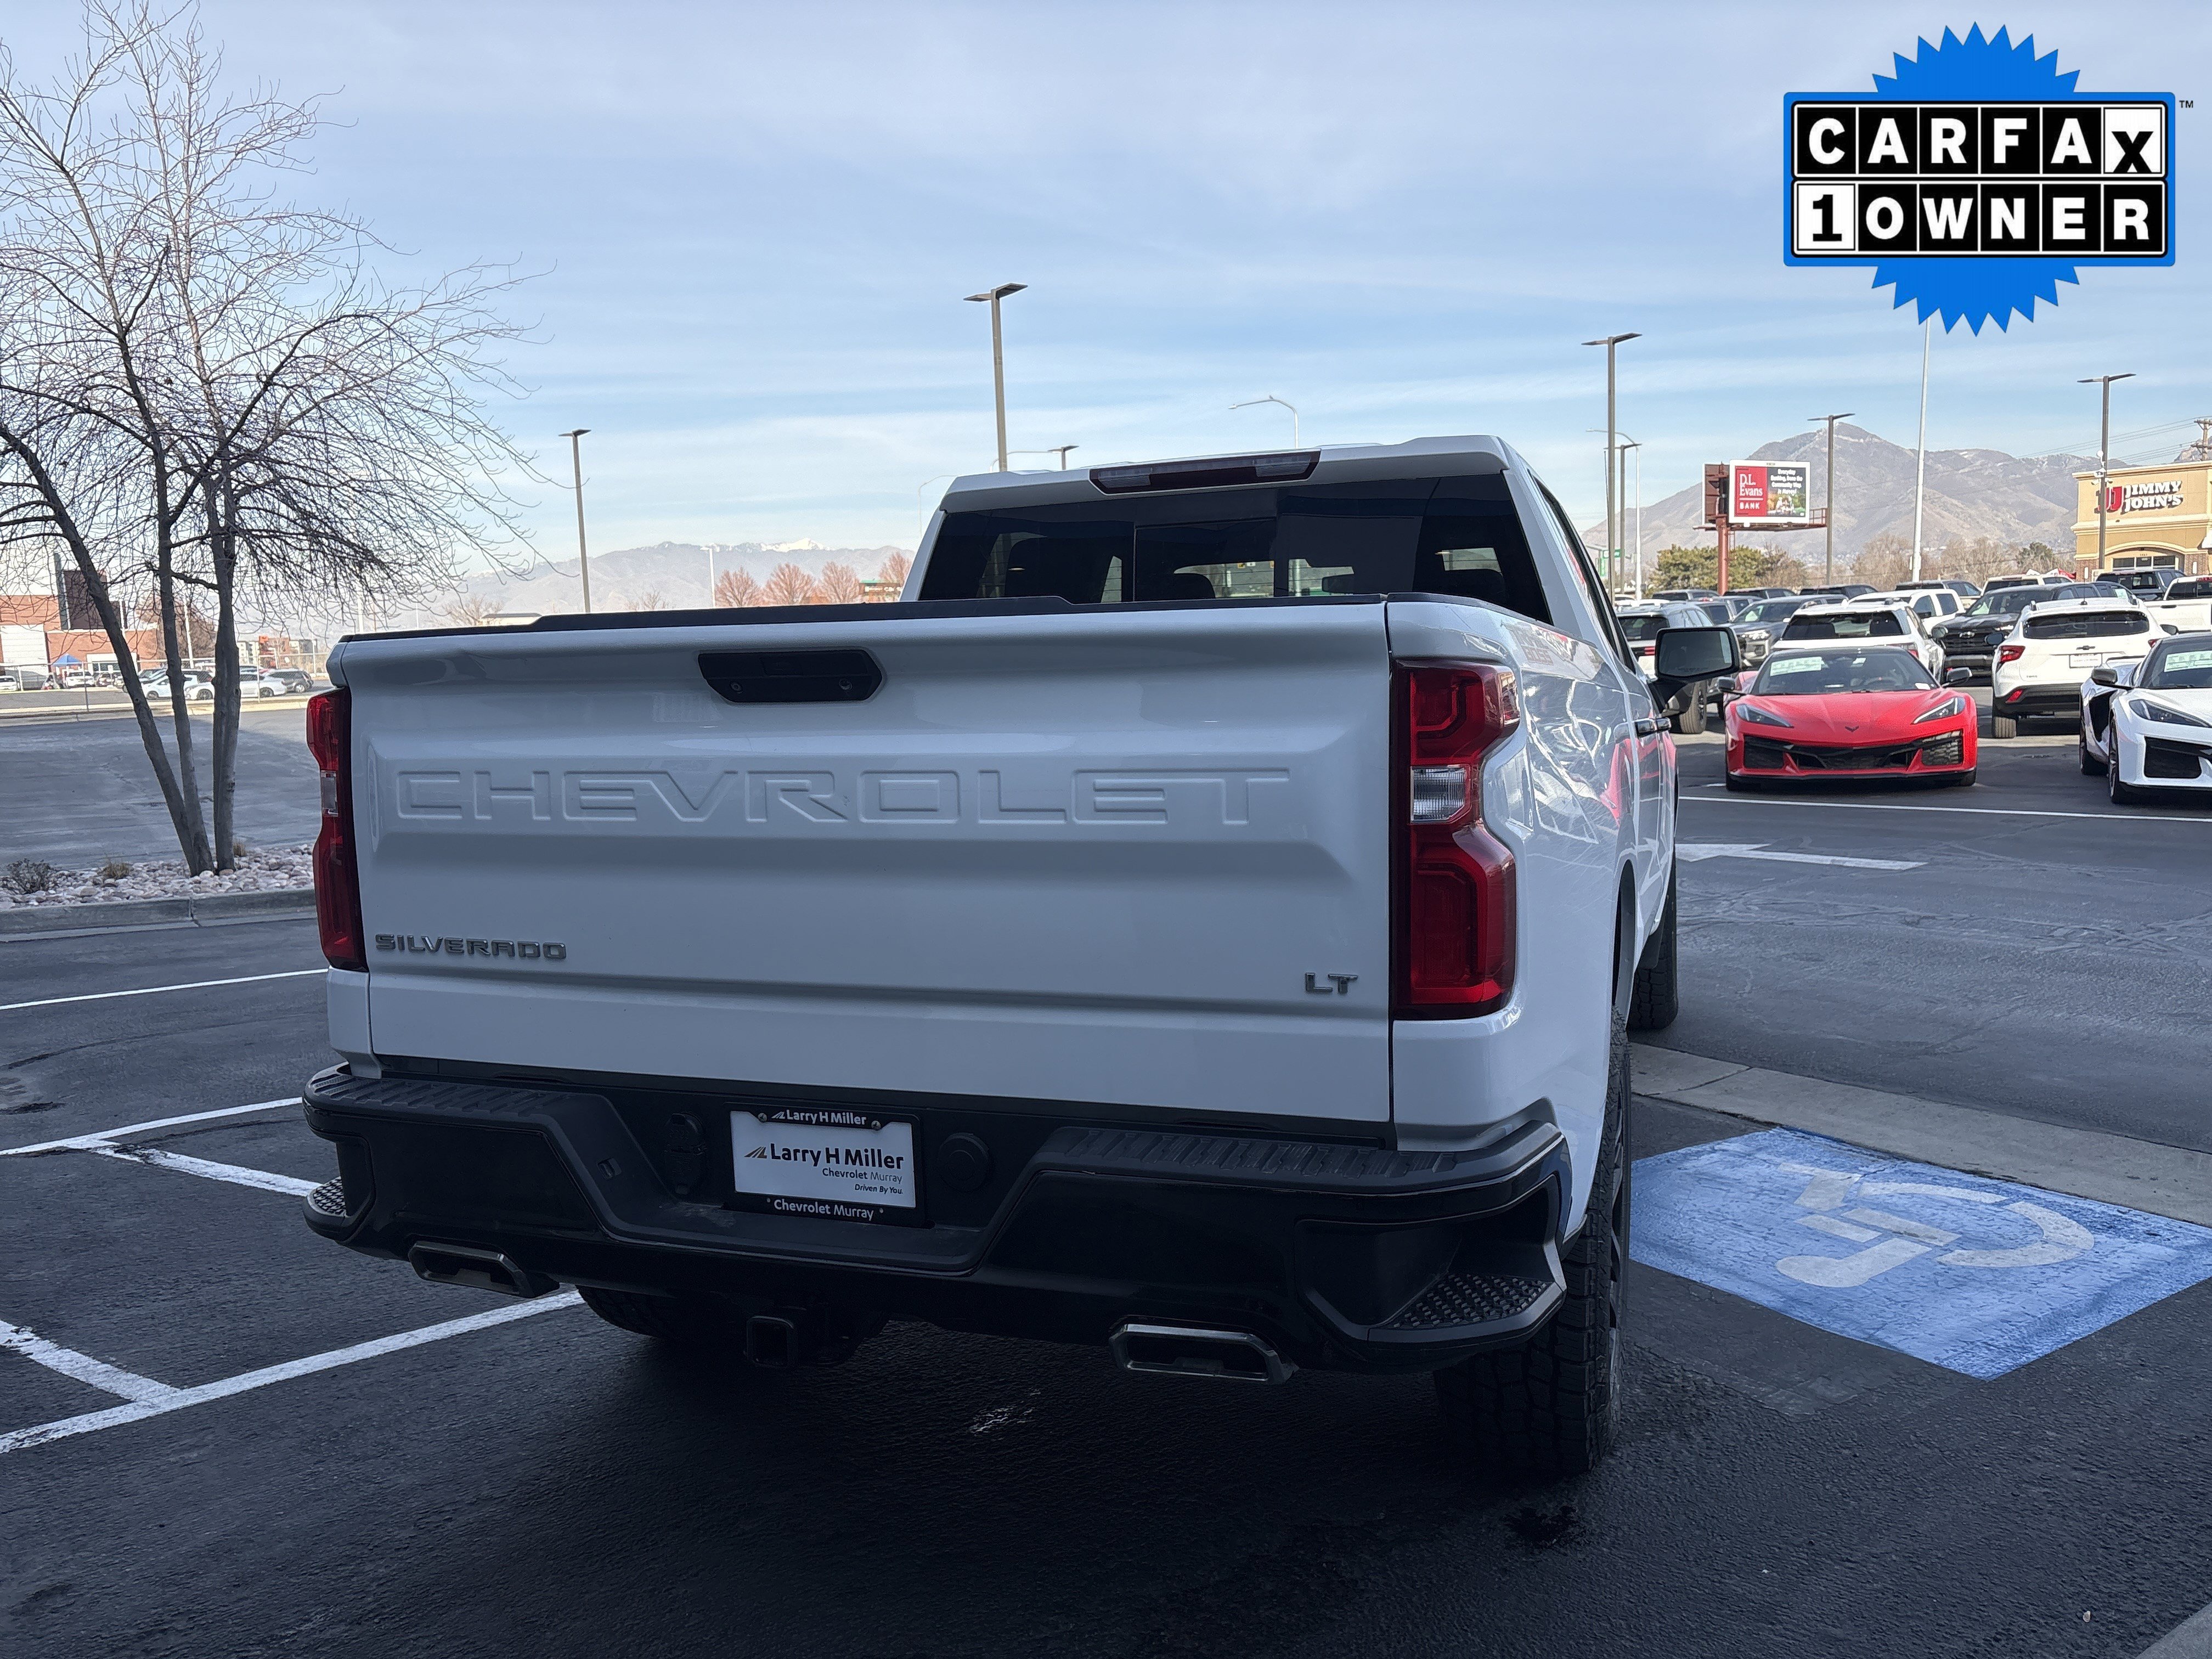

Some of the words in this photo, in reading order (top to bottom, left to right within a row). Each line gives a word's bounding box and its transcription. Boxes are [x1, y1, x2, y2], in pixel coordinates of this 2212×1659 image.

[1739, 484, 1763, 496] Evans
[2125, 480, 2182, 498] JIMMY
[2124, 494, 2183, 512] JOHN'S
[397, 768, 1290, 825] CHEVROLET
[375, 933, 567, 960] SILVERADO
[1305, 972, 1358, 994] LT
[787, 1109, 817, 1124] Larry
[820, 1111, 828, 1122] H
[831, 1112, 867, 1125] Miller
[770, 1143, 821, 1167] Larry
[826, 1147, 840, 1164] H
[845, 1148, 904, 1169] Miller
[822, 1167, 867, 1180] Chevrolet
[870, 1172, 902, 1183] Murray
[855, 1183, 877, 1193] Driven
[879, 1186, 888, 1194] By
[774, 1199, 831, 1214] Chevrolet
[833, 1206, 874, 1221] Murray
